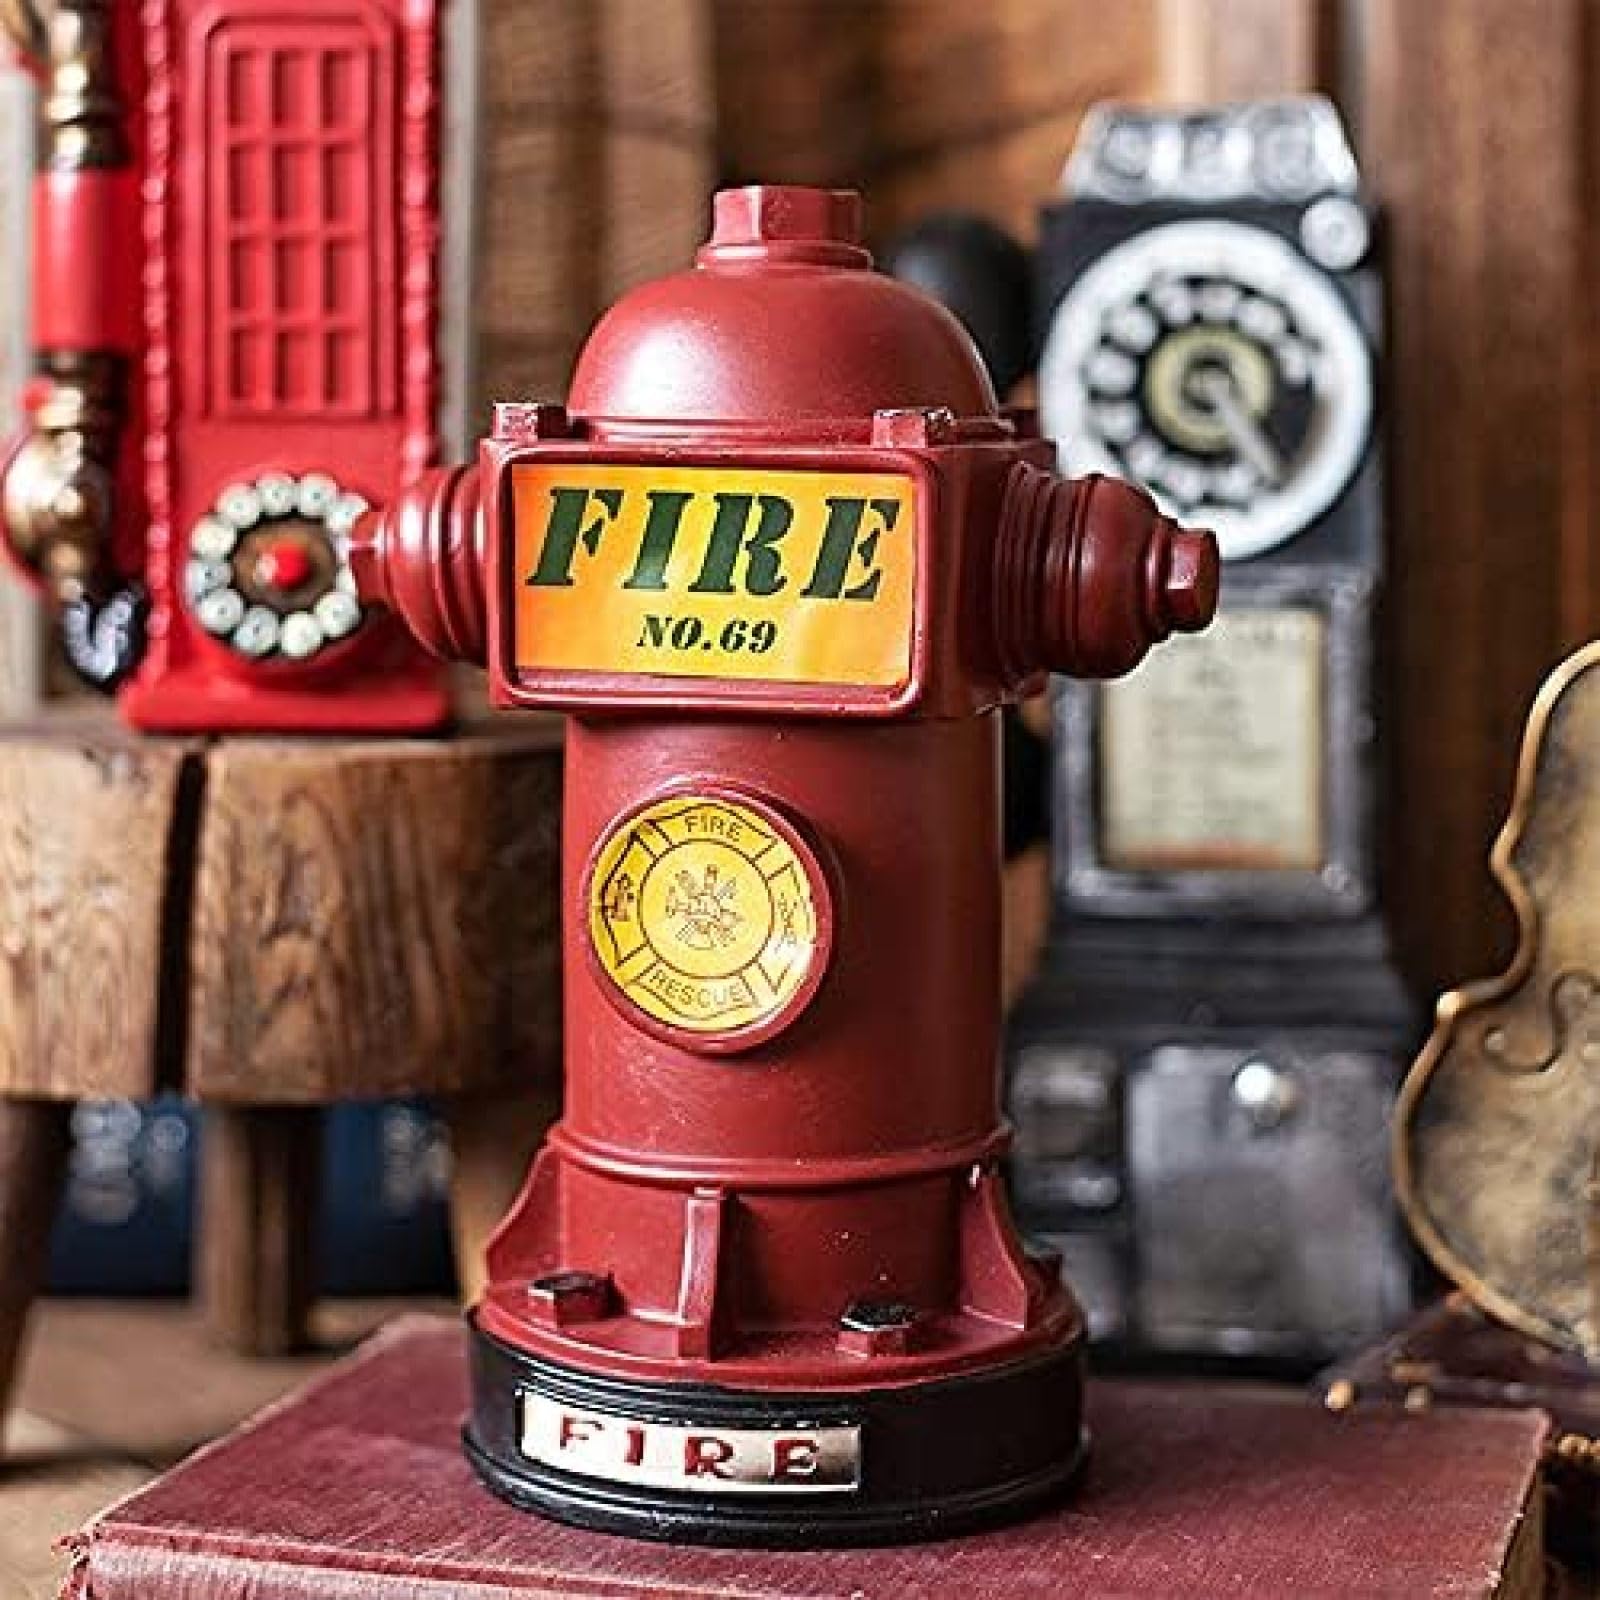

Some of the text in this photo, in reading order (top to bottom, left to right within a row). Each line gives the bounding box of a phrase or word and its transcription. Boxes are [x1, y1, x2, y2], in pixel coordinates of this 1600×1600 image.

[526, 486, 900, 600] FIRE
[637, 614, 777, 654] NO.69
[684, 814, 743, 842] FIRE
[649, 968, 744, 1009] RESCUE
[559, 1415, 820, 1479] FIRE
